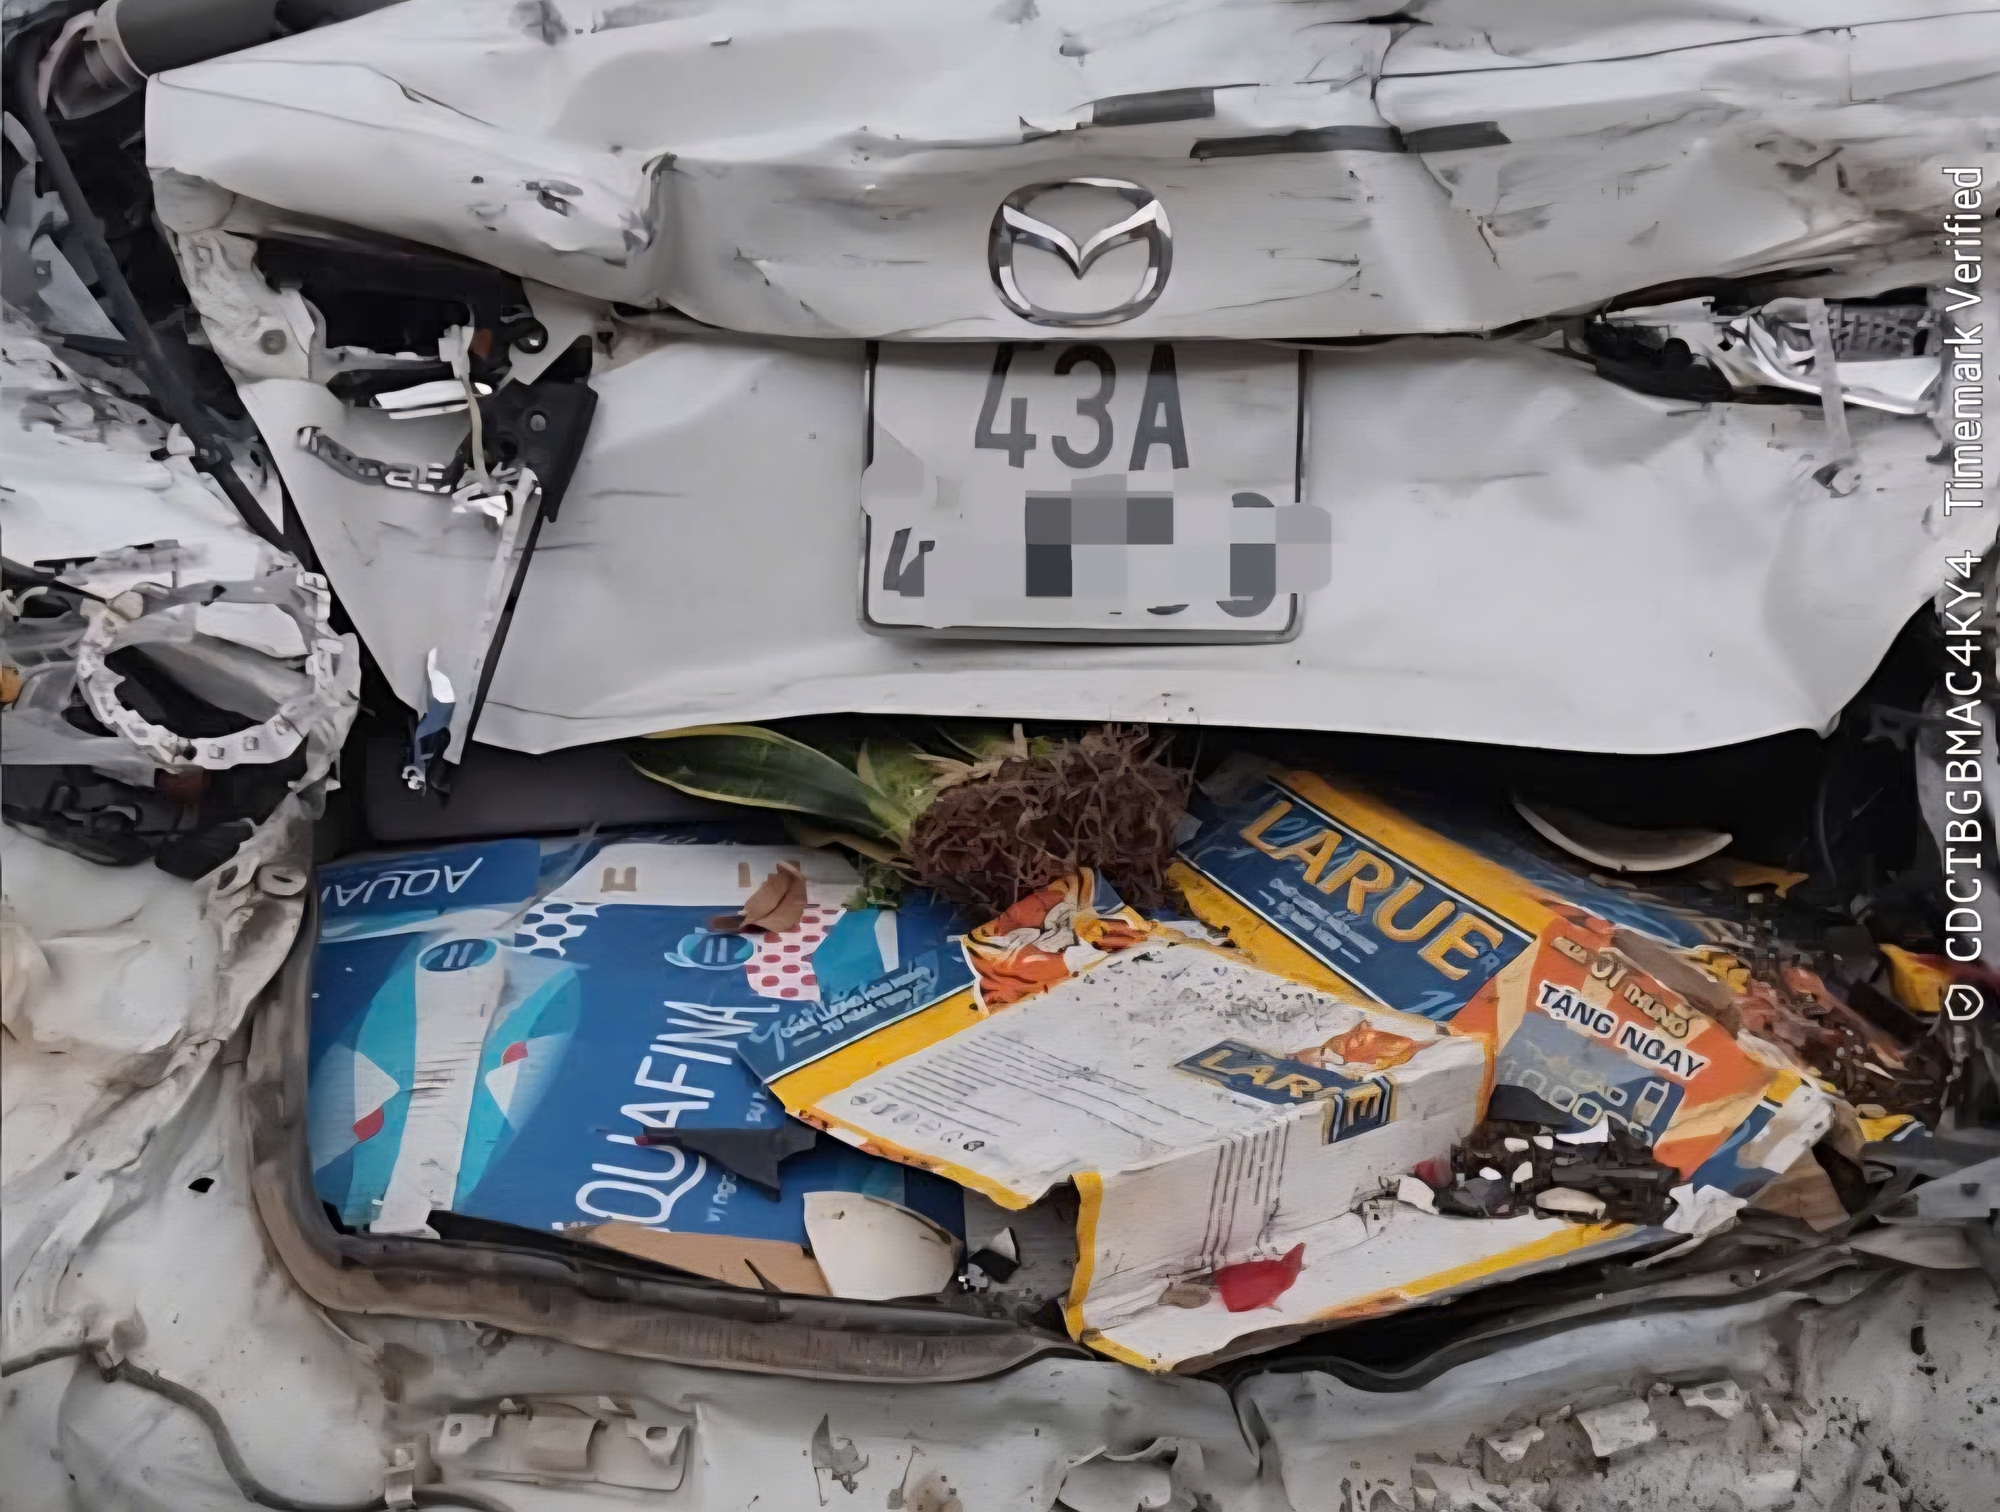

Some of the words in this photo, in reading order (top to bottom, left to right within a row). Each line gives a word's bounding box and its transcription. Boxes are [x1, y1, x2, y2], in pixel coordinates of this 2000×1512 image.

[974, 344, 1190, 471] 43A
[1238, 801, 1503, 981] LARUE
[552, 1001, 779, 1232] QUAFINA
